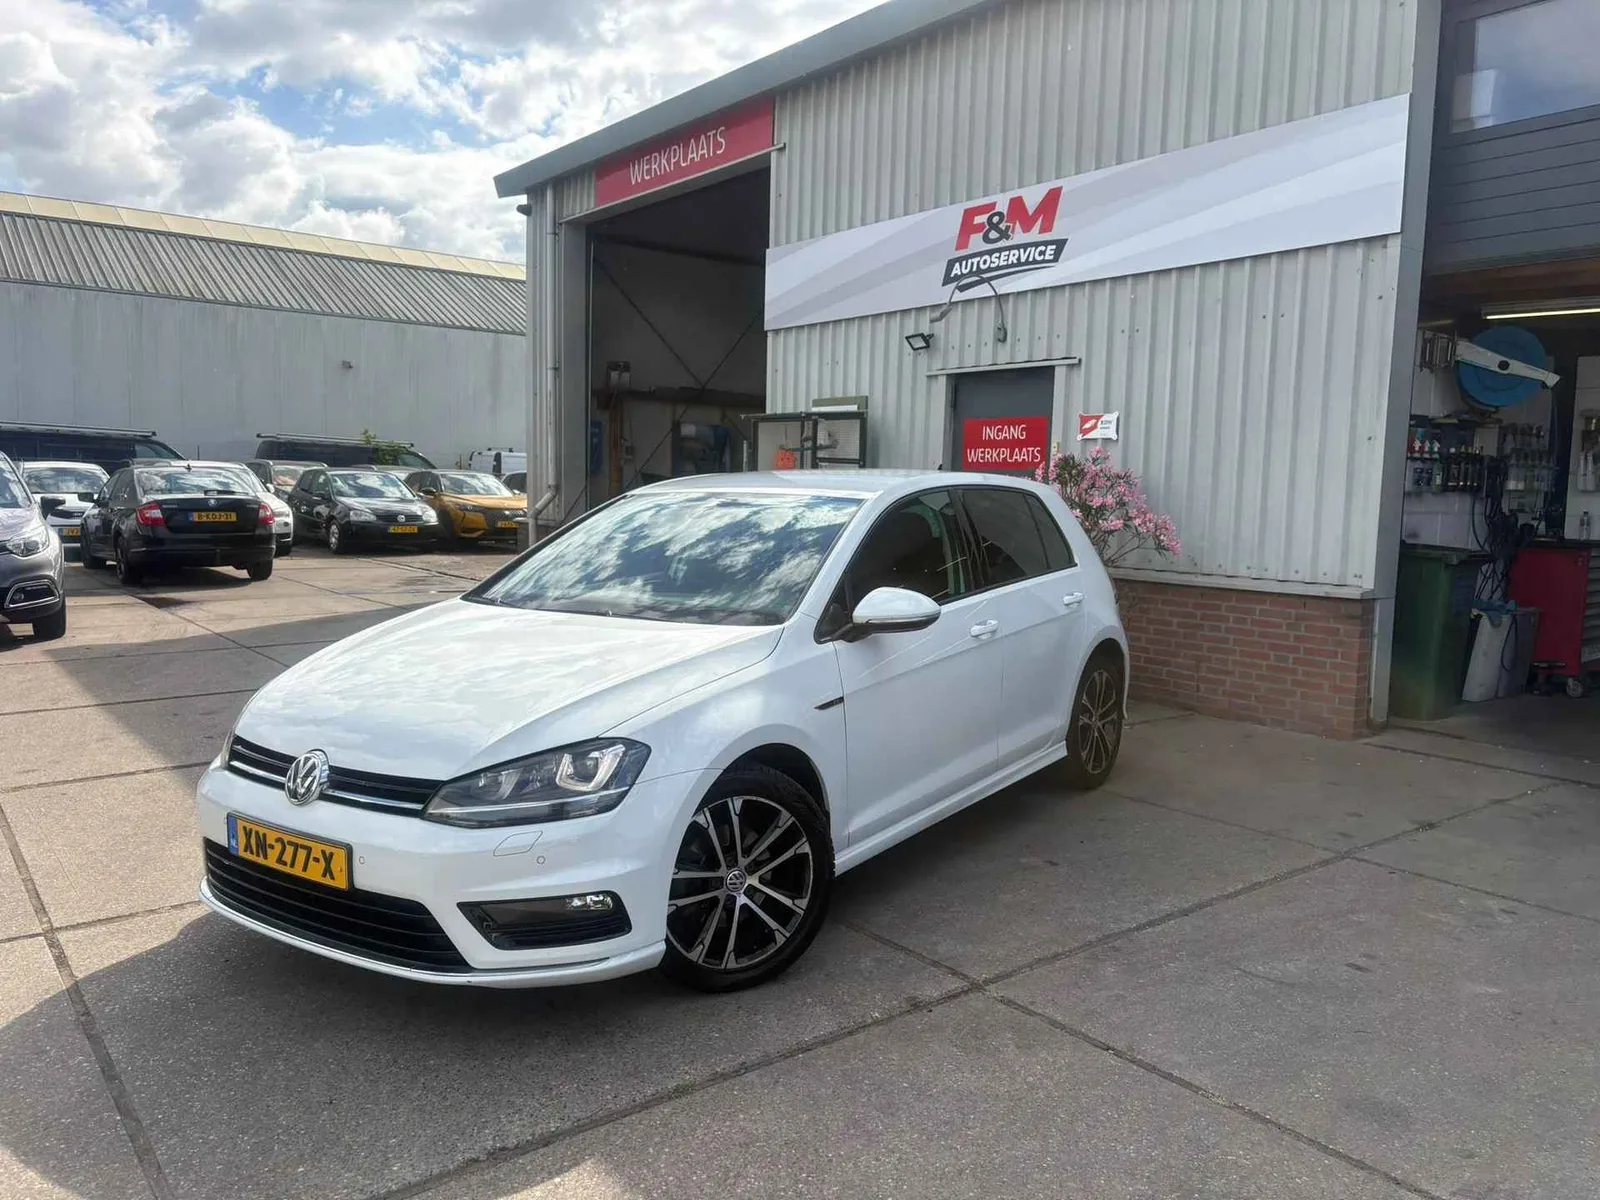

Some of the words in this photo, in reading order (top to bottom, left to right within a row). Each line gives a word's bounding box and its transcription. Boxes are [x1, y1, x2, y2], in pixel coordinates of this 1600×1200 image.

[630, 127, 726, 185] WERKPLAATS
[955, 186, 1063, 251] F&M
[950, 245, 1056, 277] AUTOSERVICE
[982, 424, 1027, 441] INGANG
[967, 447, 1041, 463] WERKPLAATS
[242, 825, 335, 881] XN-277-X
